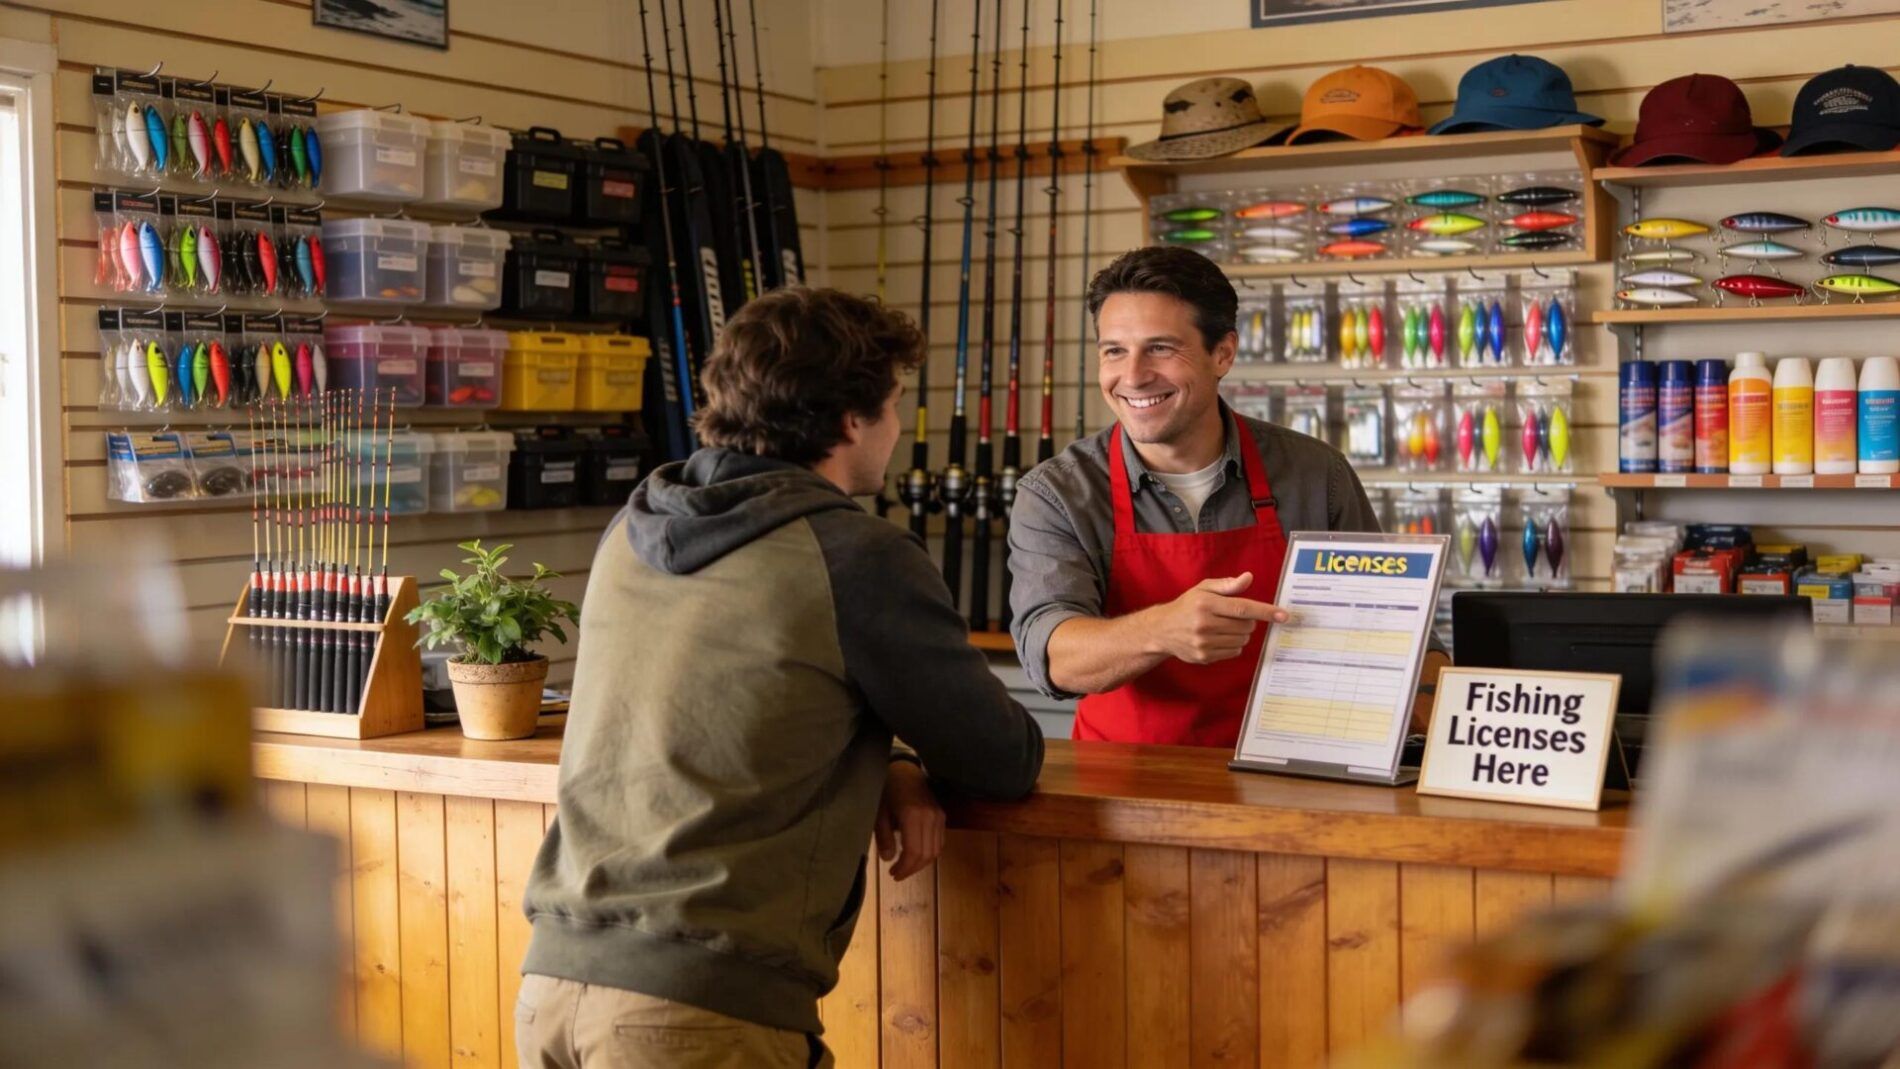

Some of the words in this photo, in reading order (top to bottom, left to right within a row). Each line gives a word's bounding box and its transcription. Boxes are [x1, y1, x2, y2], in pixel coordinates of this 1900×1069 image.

[1314, 551, 1408, 575] Licenses
[1466, 682, 1585, 725] Fishing
[1447, 715, 1587, 754] Licenses
[1472, 753, 1549, 787] Here
